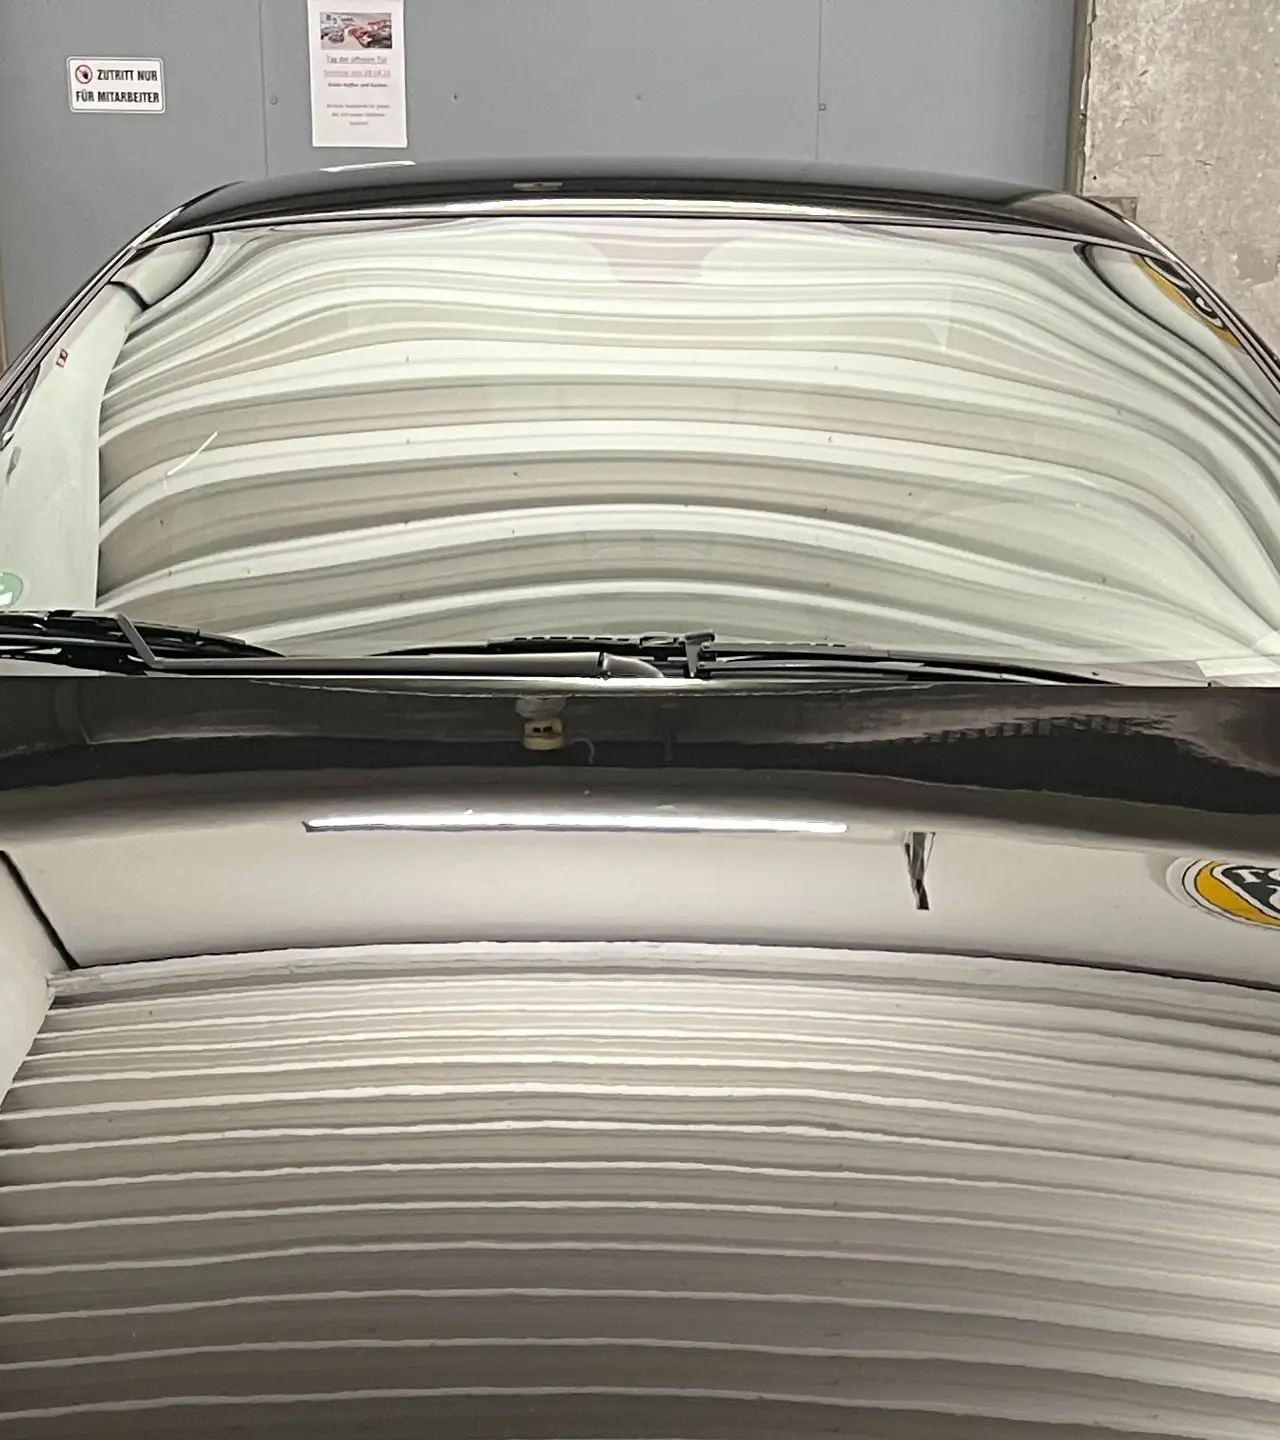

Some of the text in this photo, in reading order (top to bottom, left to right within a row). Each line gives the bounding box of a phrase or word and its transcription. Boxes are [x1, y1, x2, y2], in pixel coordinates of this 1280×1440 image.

[97, 69, 158, 81] ZUTRITT NUR
[75, 88, 160, 103] FÜR MITARBEITER
